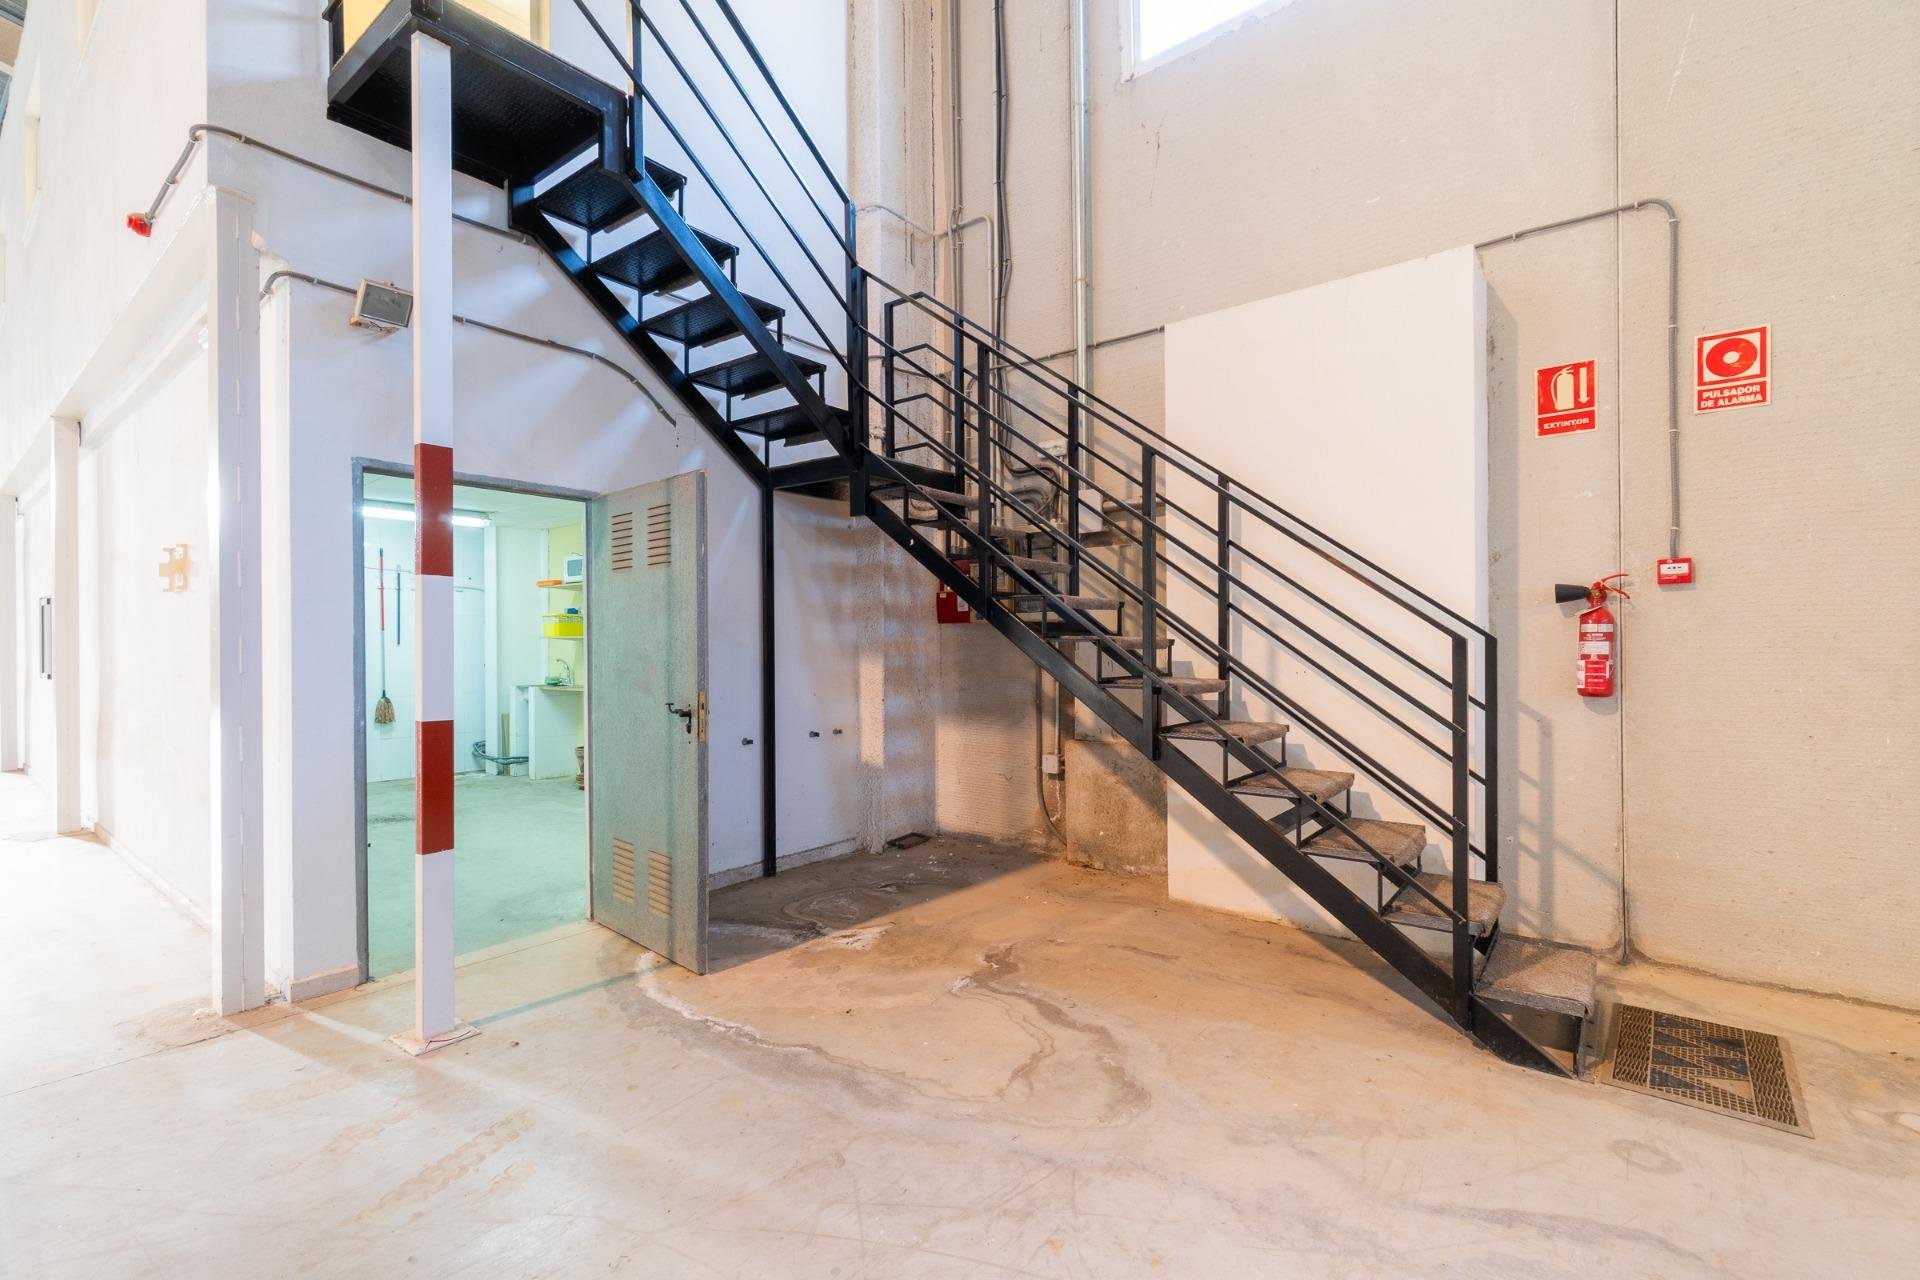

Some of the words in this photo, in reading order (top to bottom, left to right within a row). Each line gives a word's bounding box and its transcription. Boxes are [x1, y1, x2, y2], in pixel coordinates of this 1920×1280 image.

[1702, 384, 1761, 400] PULSADOR
[1700, 399, 1715, 408] DE
[1717, 393, 1763, 407] ALARMA
[1543, 417, 1590, 430] EXTINTOR
